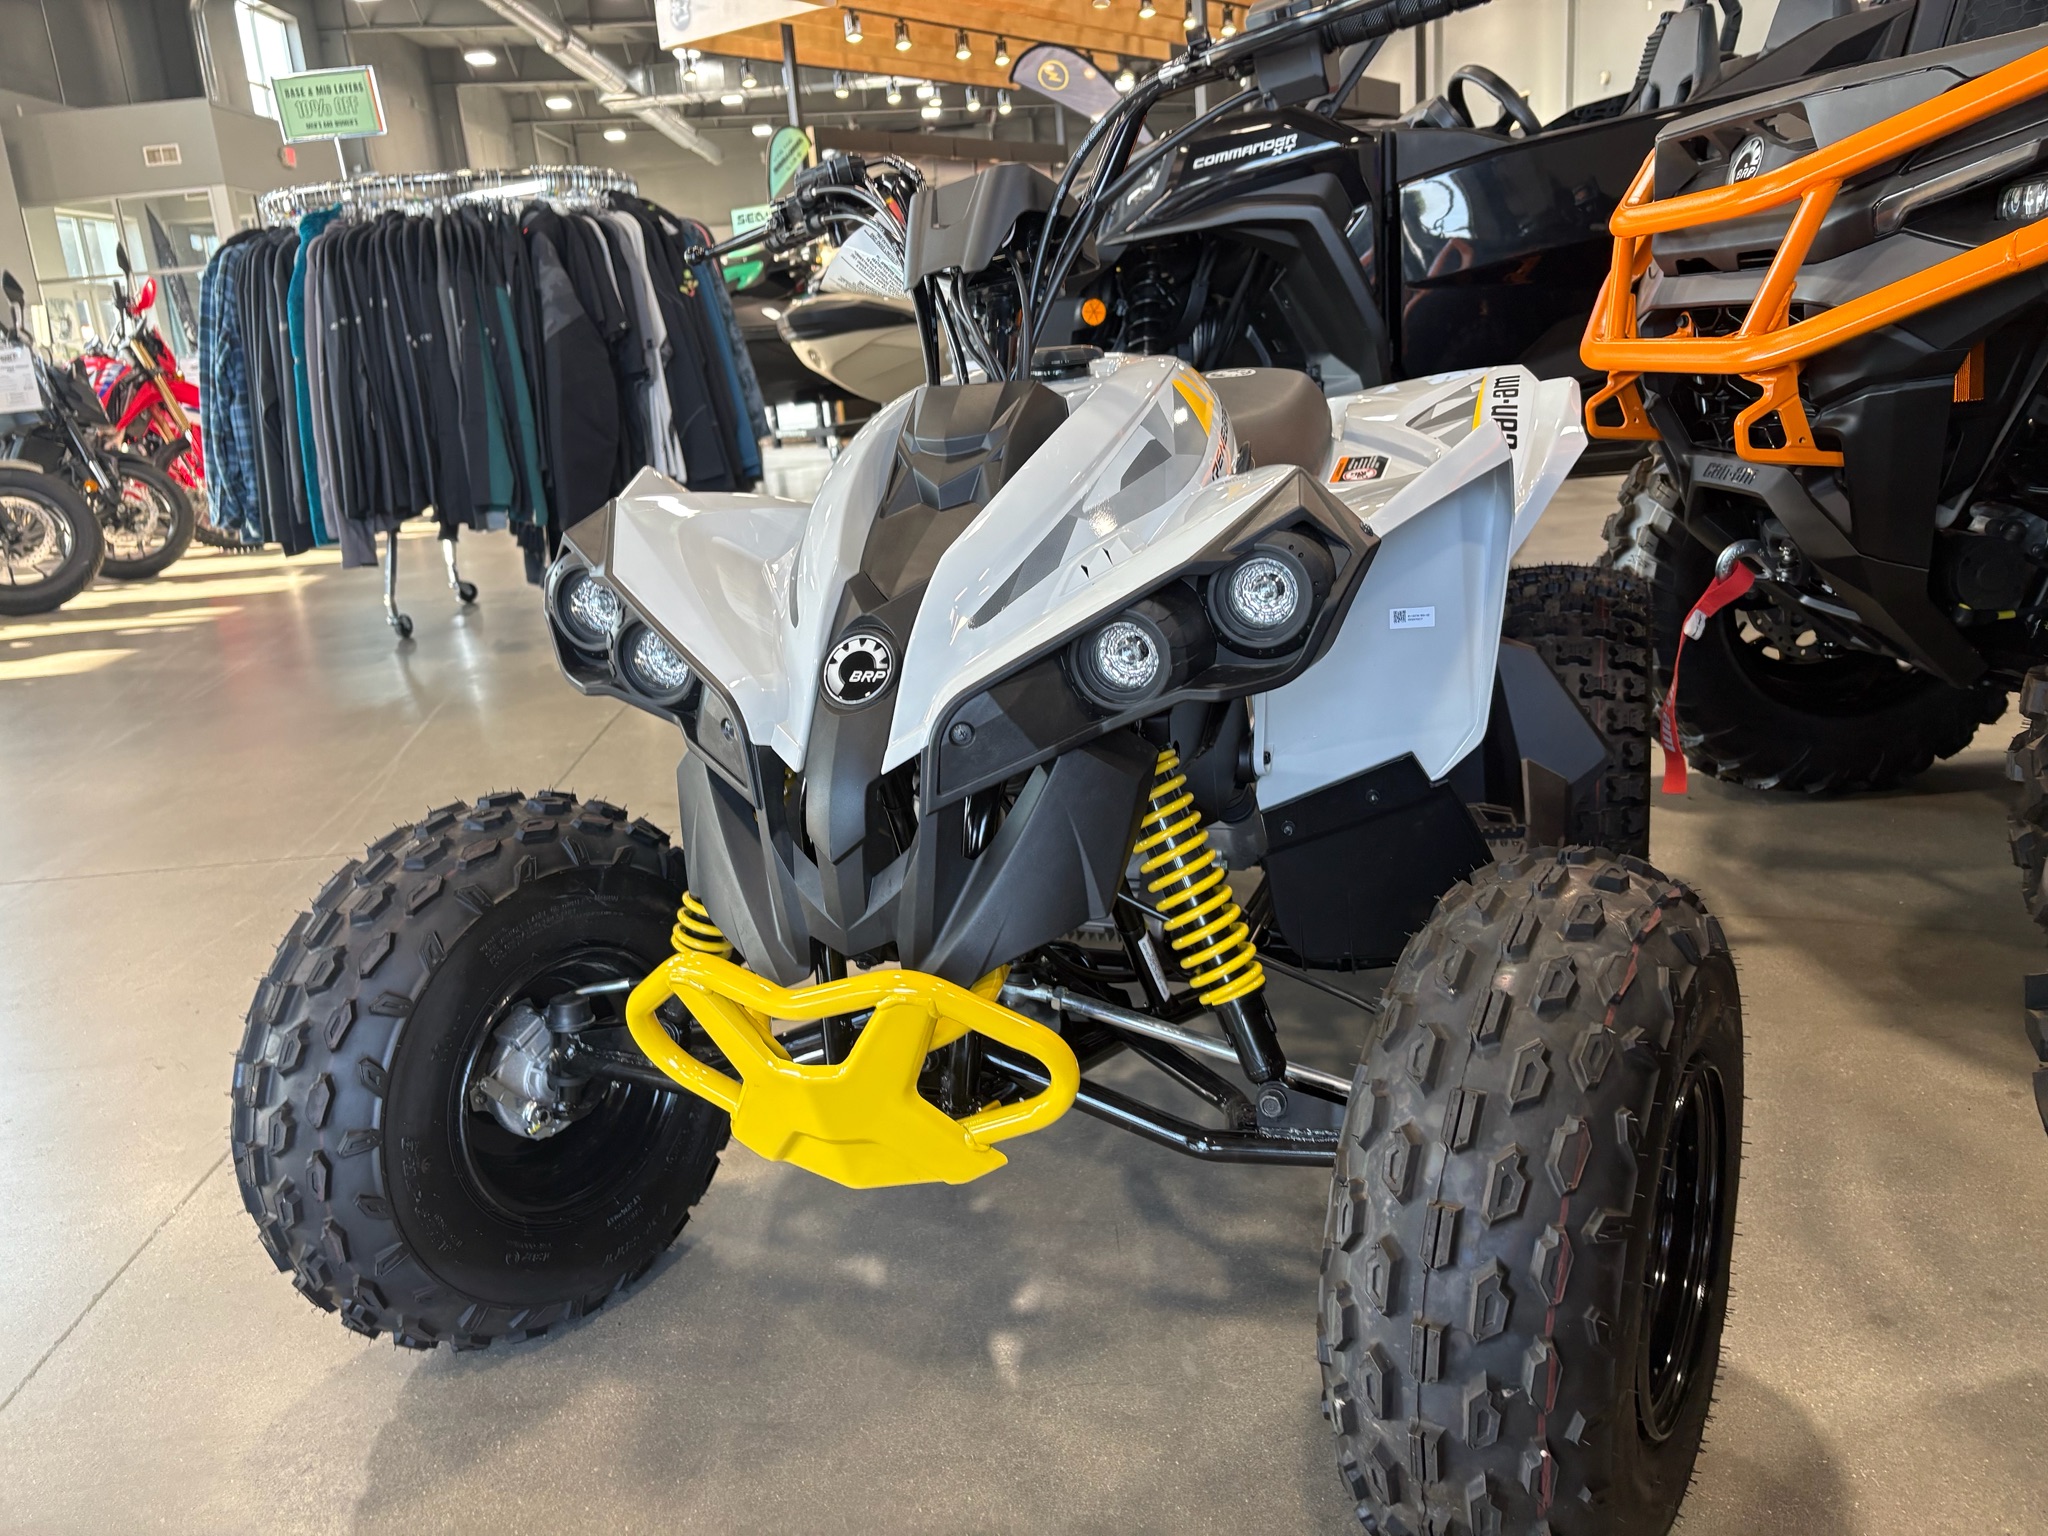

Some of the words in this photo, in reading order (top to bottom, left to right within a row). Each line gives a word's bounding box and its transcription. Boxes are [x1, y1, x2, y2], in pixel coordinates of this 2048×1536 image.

[284, 86, 306, 99] BASE
[315, 84, 332, 97] MID
[334, 81, 364, 95] LAYERS
[1193, 133, 1298, 170] COMMANDER
[1272, 144, 1297, 157] XT
[1735, 165, 1757, 181] BRP
[848, 670, 887, 684] BRP
